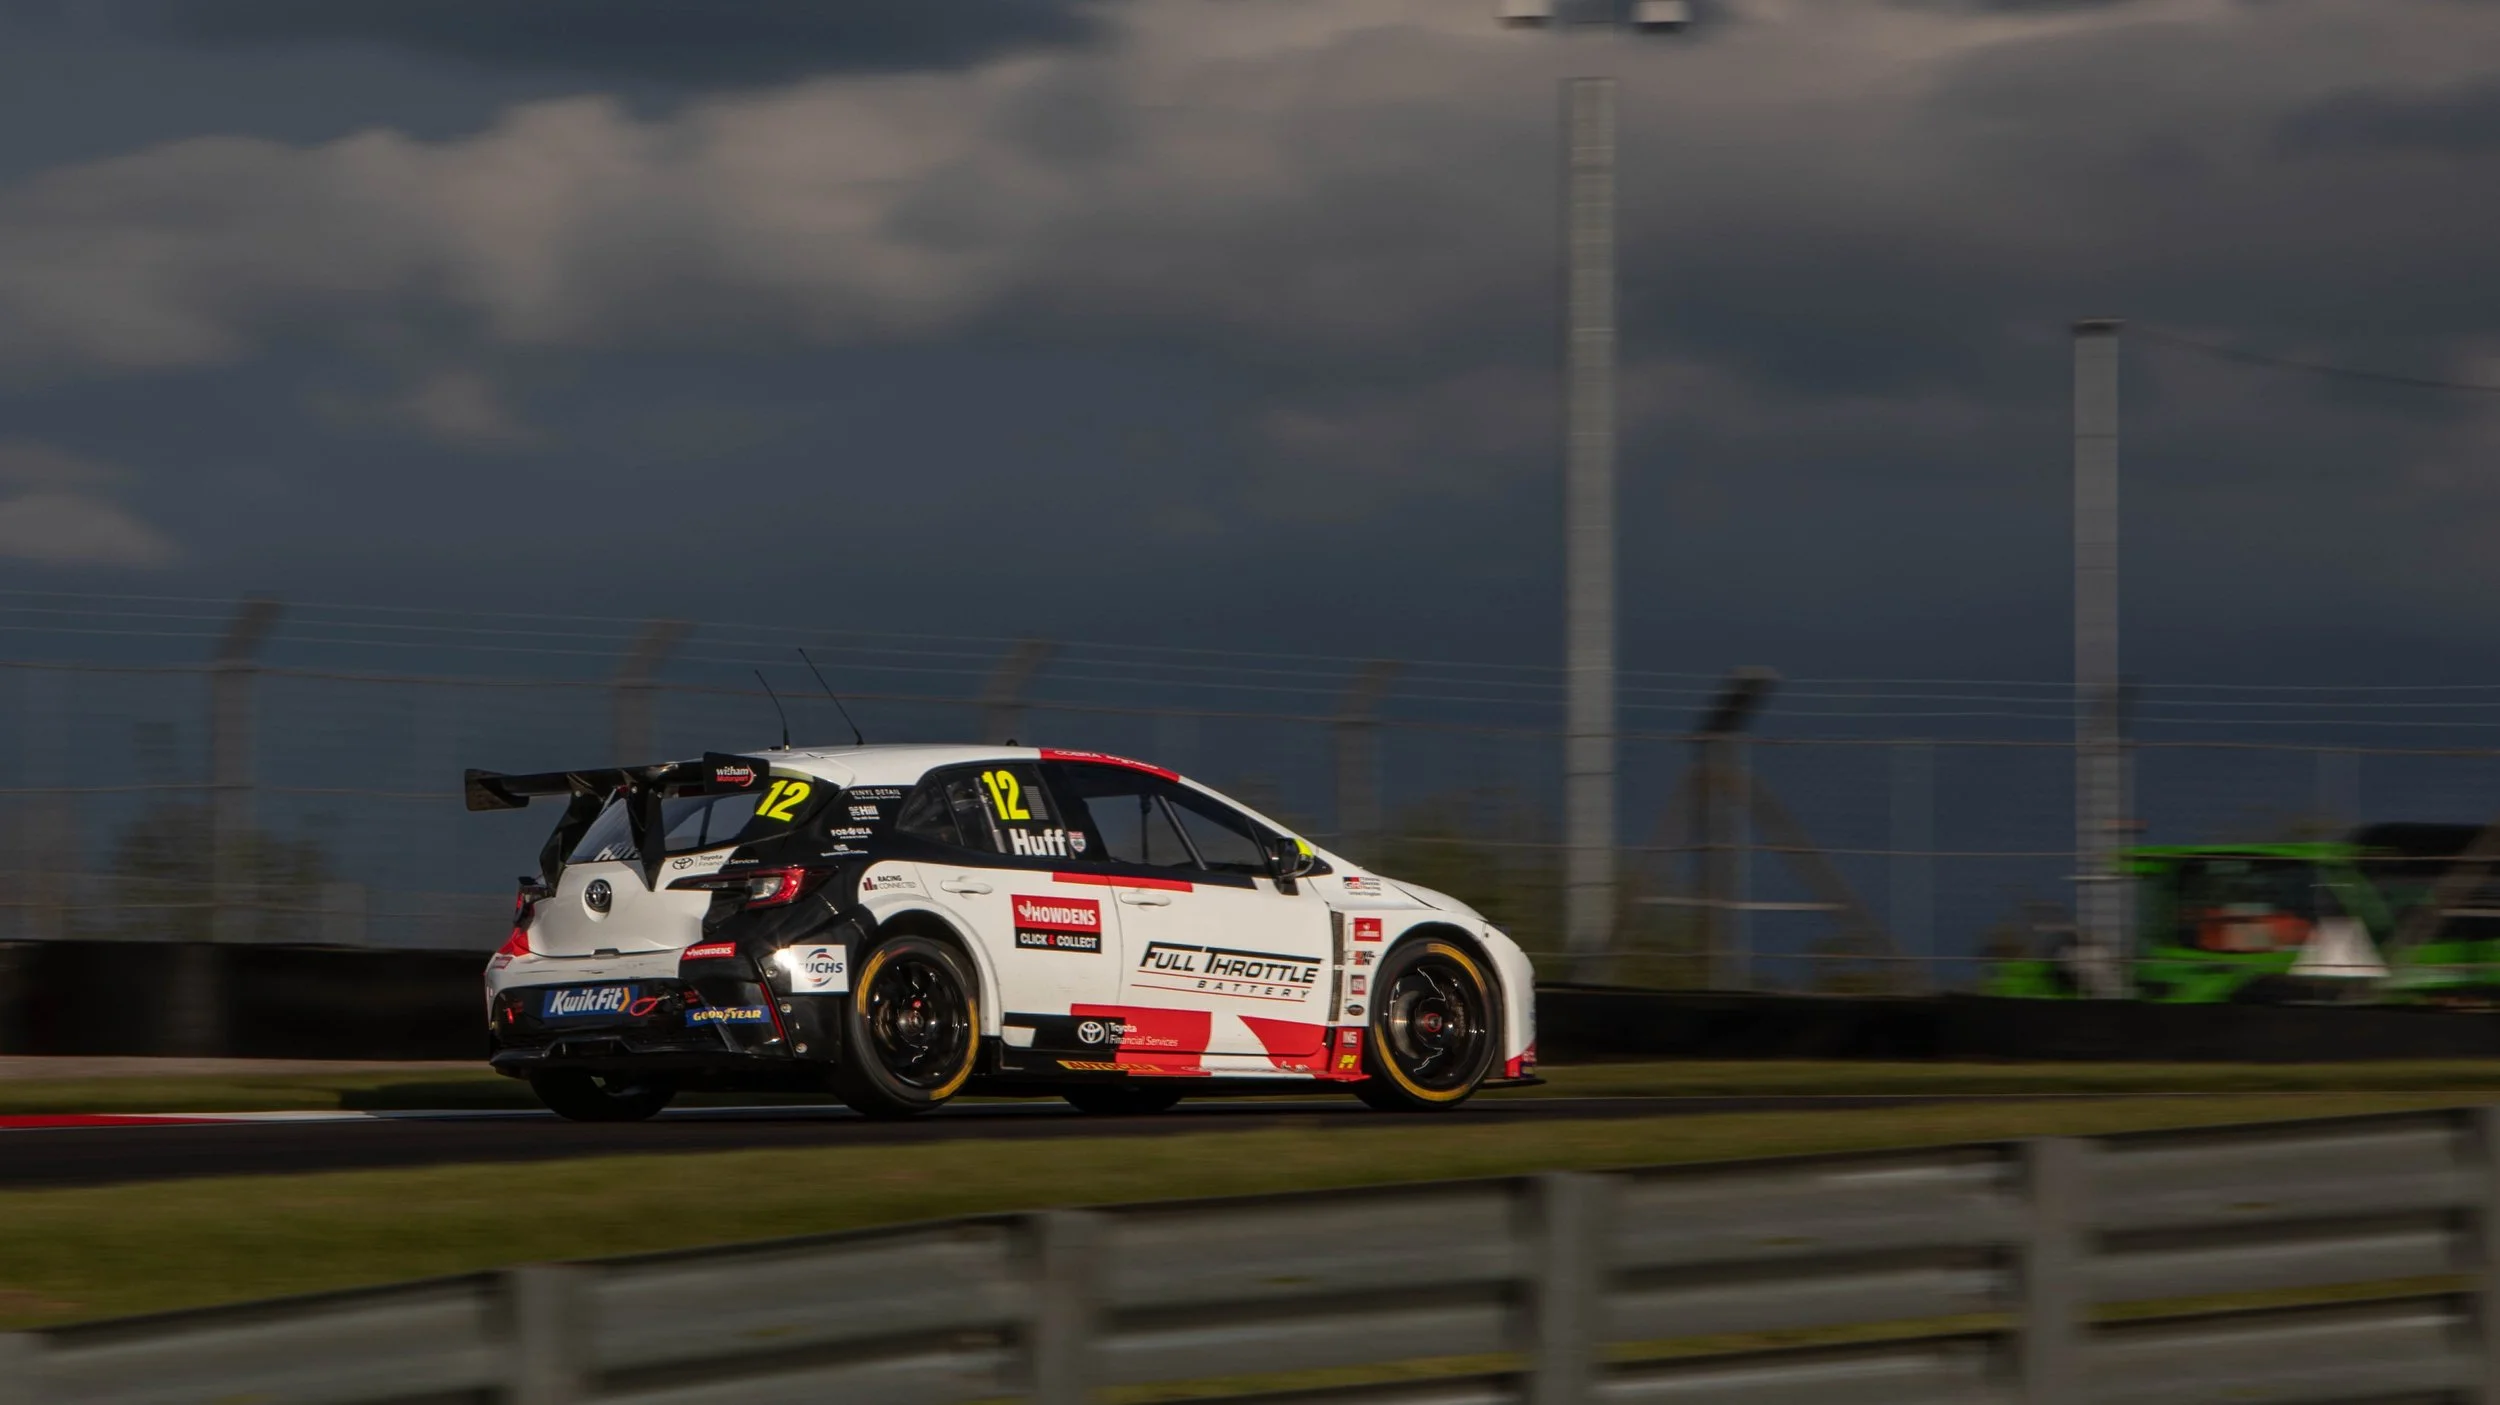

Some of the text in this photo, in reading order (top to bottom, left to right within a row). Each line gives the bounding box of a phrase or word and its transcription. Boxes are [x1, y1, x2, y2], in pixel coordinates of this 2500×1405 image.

[716, 766, 749, 775] witham
[755, 779, 812, 823] 12
[981, 770, 1031, 820] 12
[1009, 828, 1068, 856] Huff
[1031, 905, 1097, 926] HOWDENS
[1020, 932, 1048, 945] CLICK
[1056, 935, 1097, 949] COLLECT
[693, 946, 733, 958] HOWDENS
[800, 962, 844, 975] UCHS
[1140, 941, 1203, 972] FULL
[1204, 946, 1321, 984] THROTTLE
[1197, 980, 1312, 999] BATTERY
[693, 1008, 763, 1021] GOODYEAR
[1110, 1022, 1137, 1035] Toyota
[1110, 1035, 1178, 1047] Financial Services
